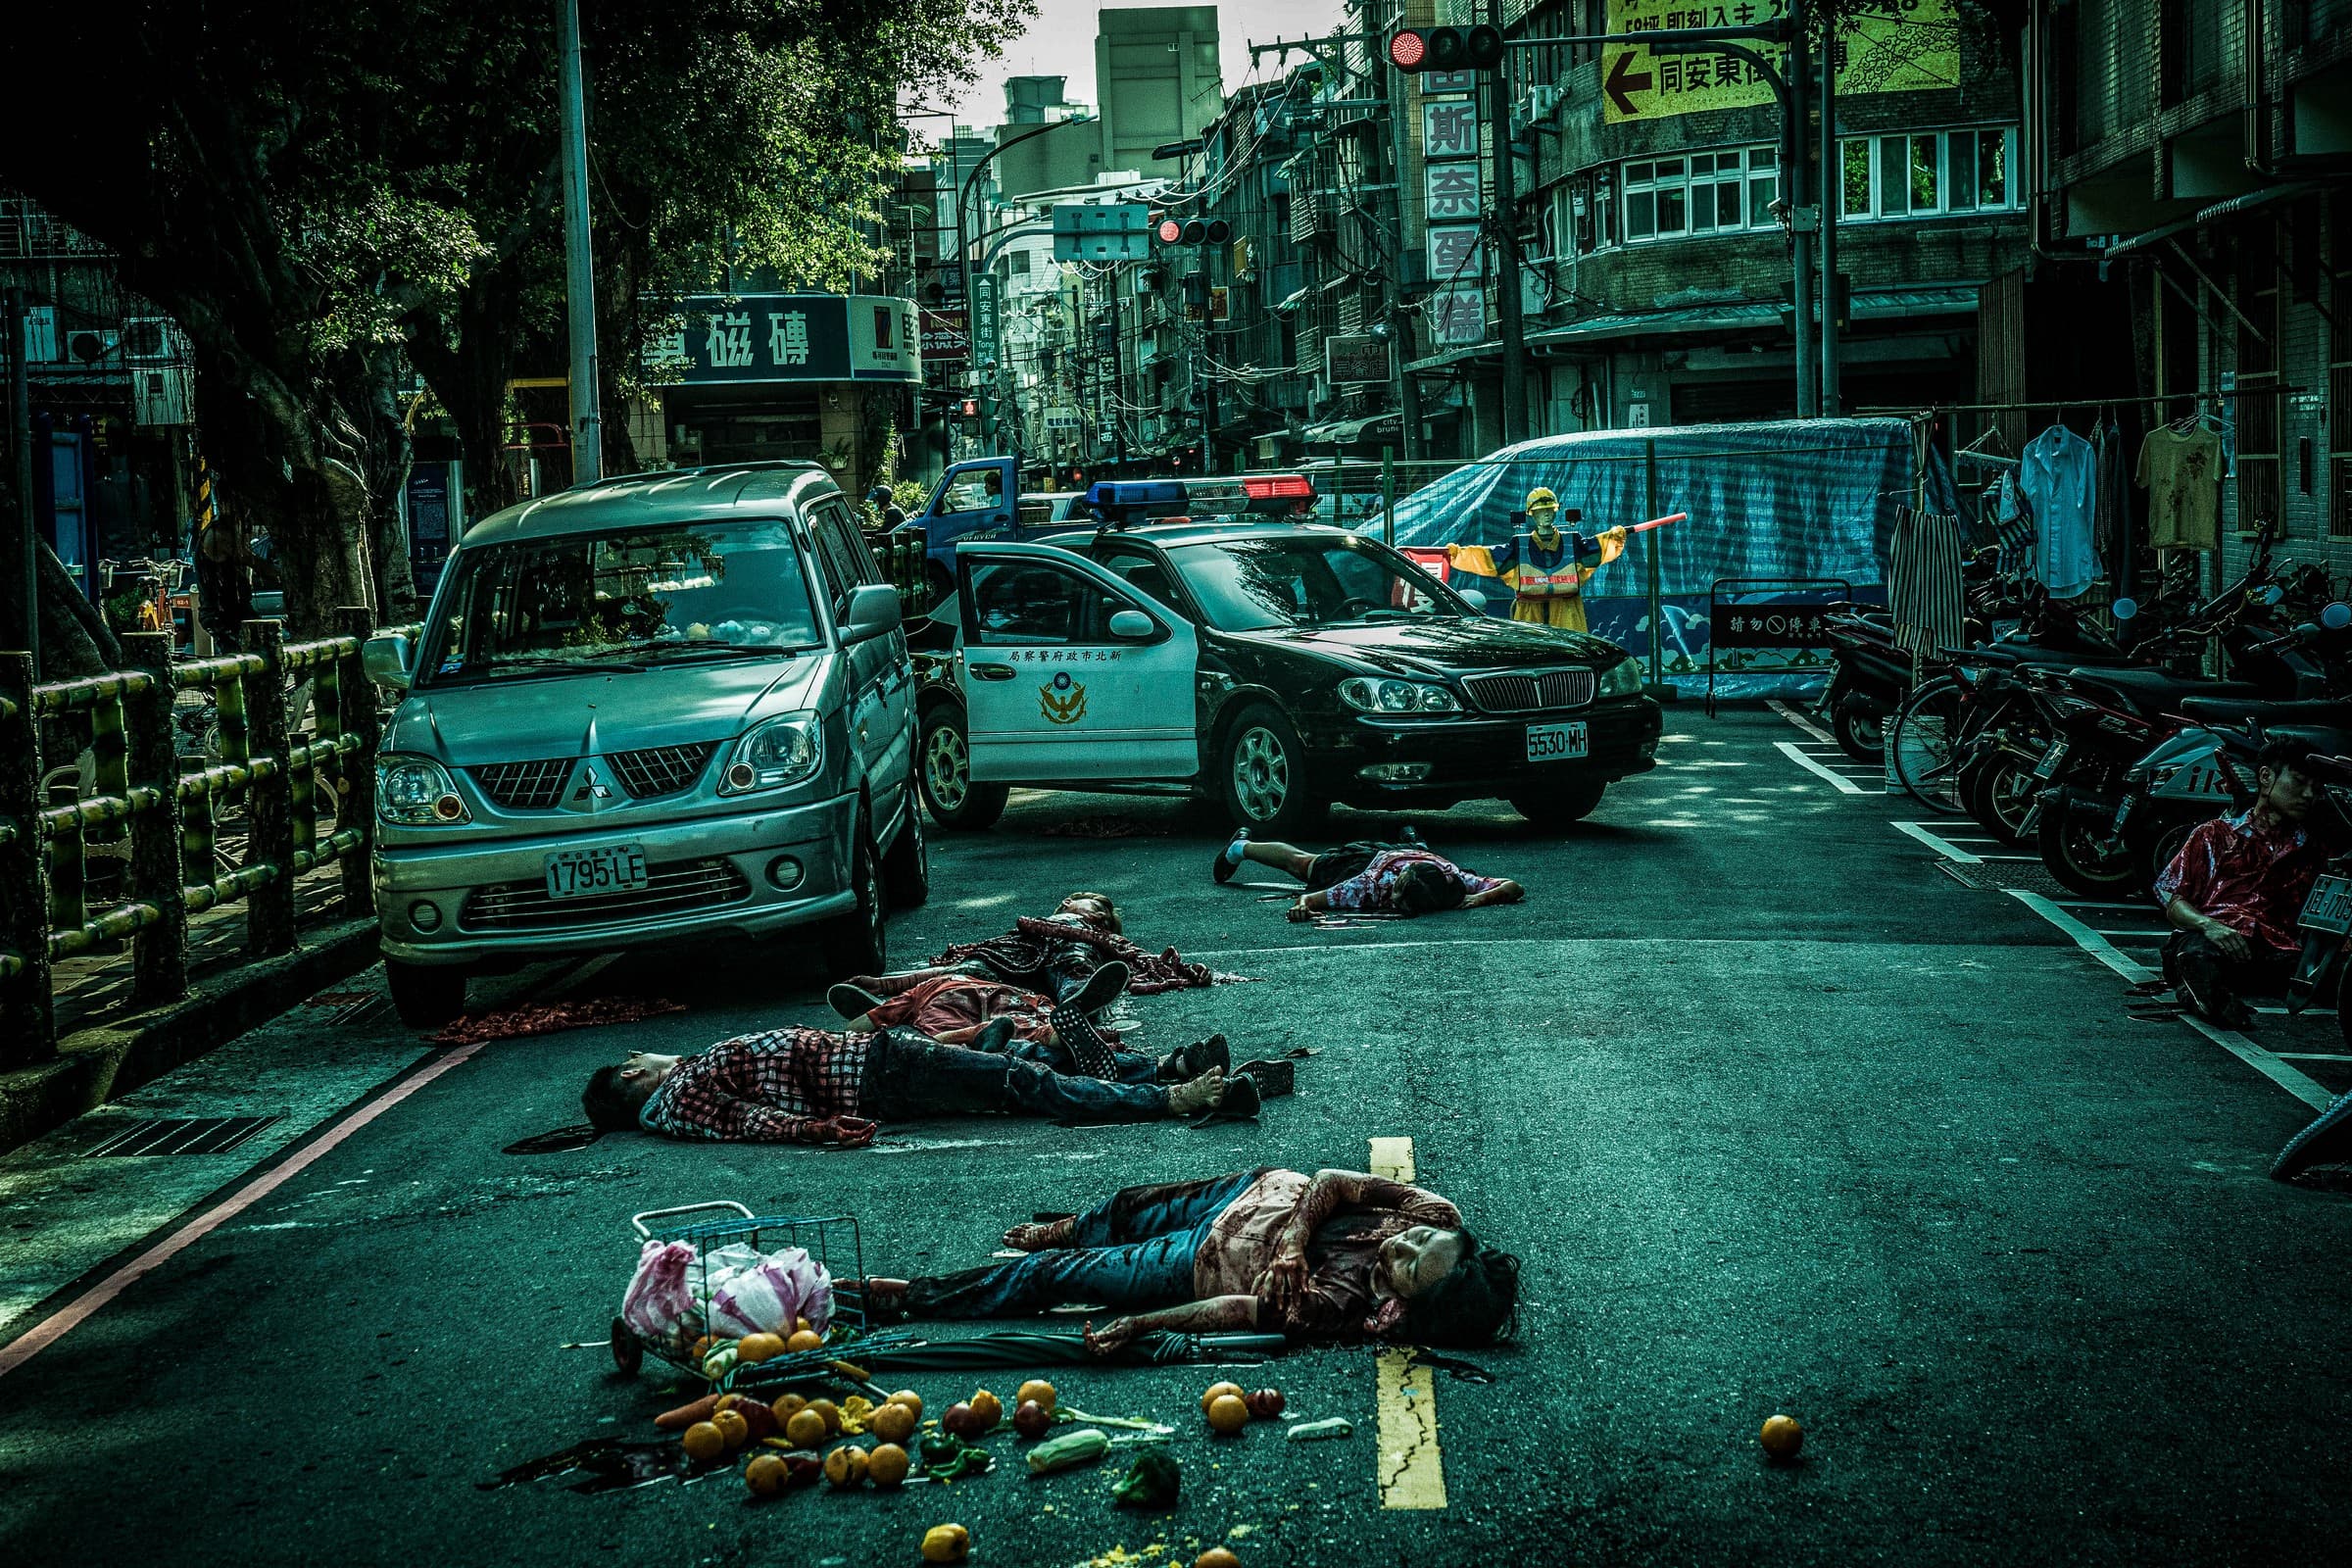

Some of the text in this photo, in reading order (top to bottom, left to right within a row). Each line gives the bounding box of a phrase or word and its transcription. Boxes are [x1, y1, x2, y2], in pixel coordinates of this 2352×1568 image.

[979, 286, 993, 339] 同安東街
[976, 340, 995, 350] Tong
